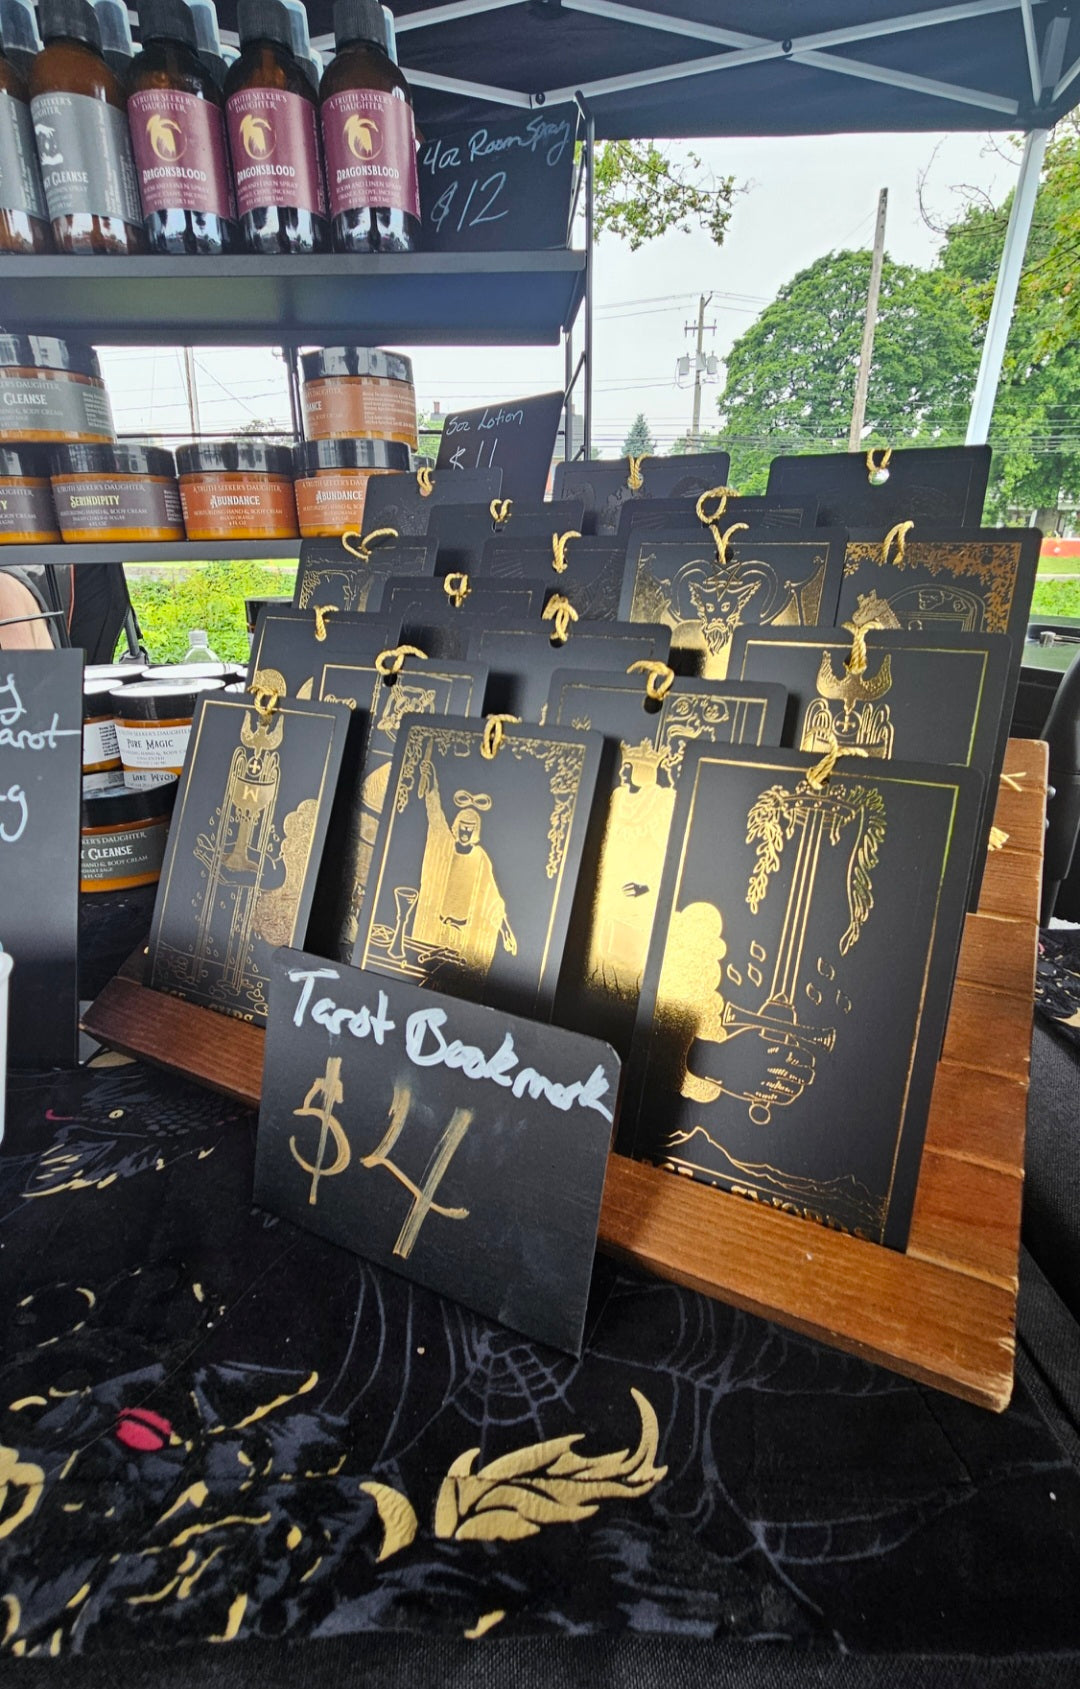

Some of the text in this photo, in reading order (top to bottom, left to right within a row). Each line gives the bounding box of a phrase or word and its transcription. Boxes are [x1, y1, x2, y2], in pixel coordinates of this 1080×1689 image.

[340, 101, 384, 113] DAUGHTER
[468, 129, 524, 162] Room
[51, 170, 89, 186] CLEANSE
[143, 166, 207, 185] DRAGONSBLOOD
[237, 164, 296, 186] DRAGONSBLOOD
[336, 165, 400, 184] DRAGONSBLOOD
[3, 391, 48, 406] CLEANSE
[477, 408, 524, 431] Lotion
[104, 481, 147, 492] DAUGHTER
[210, 494, 260, 509] ABUNDANCE
[315, 490, 363, 504] ABUNDANCE
[0, 713, 82, 749] arot
[127, 738, 174, 751] PURE MAGIC
[102, 831, 148, 844] DAUGHTER
[88, 845, 133, 861] CLEANSE
[125, 855, 148, 864] CREAM
[287, 968, 614, 1124] Tarot Bookmark
[289, 1056, 475, 1260] $4
